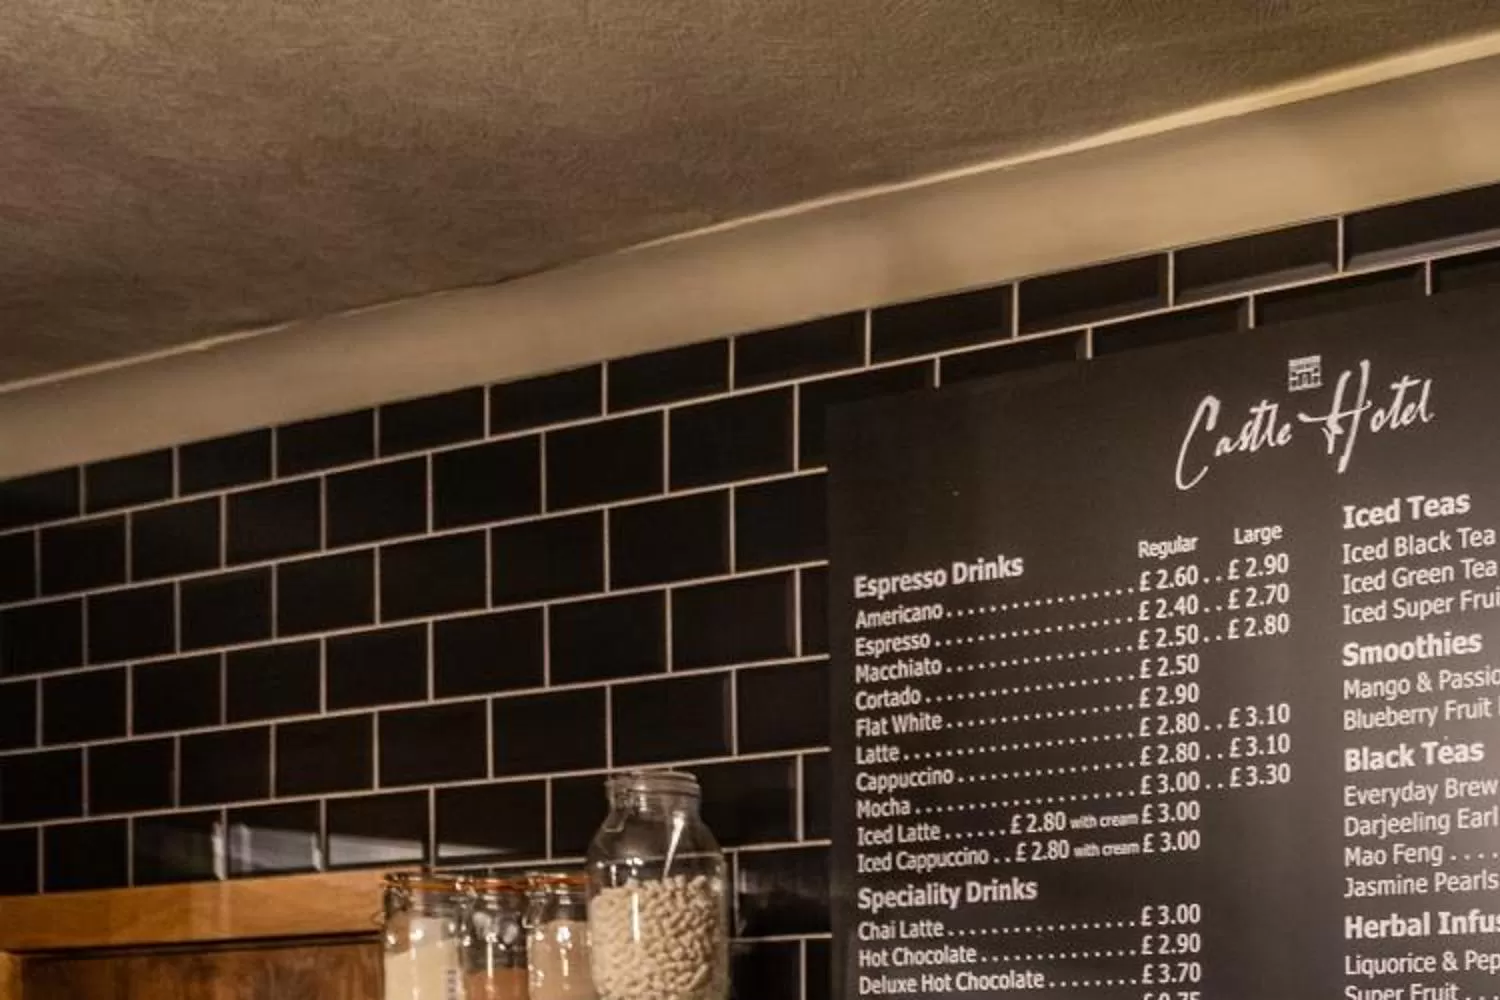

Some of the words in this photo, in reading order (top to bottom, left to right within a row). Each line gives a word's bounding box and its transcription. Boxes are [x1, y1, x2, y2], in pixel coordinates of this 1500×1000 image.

[1174, 394, 1293, 491] Castle
[1296, 358, 1435, 475] Hotel
[1341, 498, 1402, 531] Iced
[1405, 492, 1472, 521] Teas
[1137, 534, 1200, 561] Regular
[1233, 524, 1284, 546] Large
[1341, 537, 1389, 565] Iced
[1393, 530, 1453, 558] Black
[1455, 526, 1497, 549] Tea
[852, 567, 949, 600] Espresso
[951, 553, 1025, 586] Drinks
[1341, 568, 1387, 596] Iced
[1391, 564, 1455, 589] Green
[1459, 557, 1499, 580] Tea
[854, 602, 945, 631] Americano
[1342, 599, 1388, 626] Iced
[1392, 596, 1456, 621] Super
[854, 631, 932, 659] Espresso
[1341, 630, 1483, 668] Smoothies
[854, 656, 944, 685] Macchiato
[1343, 677, 1412, 701] Mango
[1415, 671, 1433, 693] &
[854, 685, 923, 712] Cortado
[854, 716, 889, 739] Flat
[893, 711, 944, 735] White
[1343, 705, 1439, 732] Blueberry
[1444, 697, 1493, 721] Fruit
[855, 744, 901, 766] Latte
[1343, 742, 1416, 773] Black
[1419, 735, 1485, 766] Teas
[854, 765, 956, 794] Cappuccino
[1343, 780, 1439, 808] Everyday
[1444, 777, 1499, 799] Brew
[855, 797, 912, 820] Mocha
[1343, 811, 1451, 840] Darjeeling
[1456, 805, 1499, 829] Earl
[856, 824, 894, 847] Iced
[897, 821, 942, 843] Latte
[1069, 813, 1099, 830] with
[1098, 812, 1140, 829] cream
[856, 851, 893, 874] Iced
[895, 845, 991, 873] Cappuccino
[1073, 843, 1100, 859] with
[1100, 841, 1141, 857] cream
[1343, 845, 1388, 868] Mao
[1392, 843, 1444, 867] Feng
[856, 882, 963, 915] Speciality
[965, 876, 1039, 904] Drinks
[1343, 873, 1429, 899] Jasmine
[1433, 868, 1500, 893] Pearls
[856, 920, 897, 942] Chai
[899, 919, 945, 939] Latte
[1343, 910, 1431, 941] Herbal
[857, 948, 890, 969] Hot
[891, 944, 978, 967] Chocolate
[1344, 951, 1438, 979] Liquorice
[1441, 949, 1460, 973] &
[858, 974, 919, 996] Deluxe
[920, 973, 954, 993] Hot
[954, 968, 1046, 993] Chocolate
